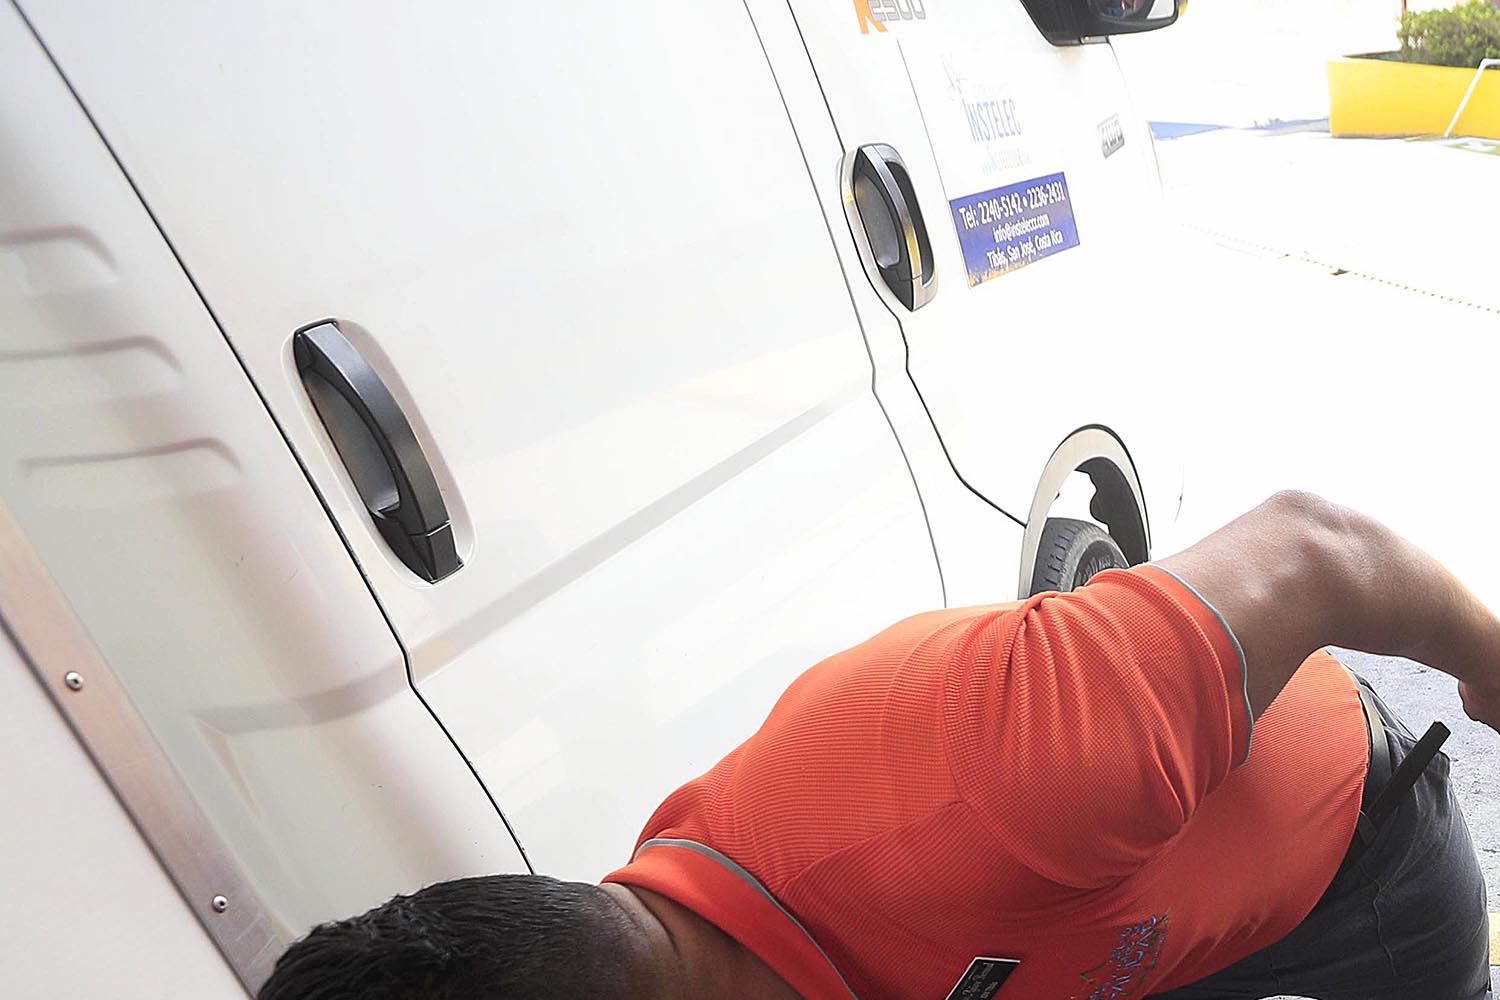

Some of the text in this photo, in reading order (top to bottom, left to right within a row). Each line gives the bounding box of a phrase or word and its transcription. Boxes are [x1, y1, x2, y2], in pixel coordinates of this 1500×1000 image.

[962, 98, 1021, 143] INSTELEC
[959, 204, 979, 230] Tel:
[978, 192, 1023, 225] 2240-5142
[1007, 243, 1020, 262] San
[1034, 233, 1051, 252] Costa
[1049, 228, 1064, 247] Rica
